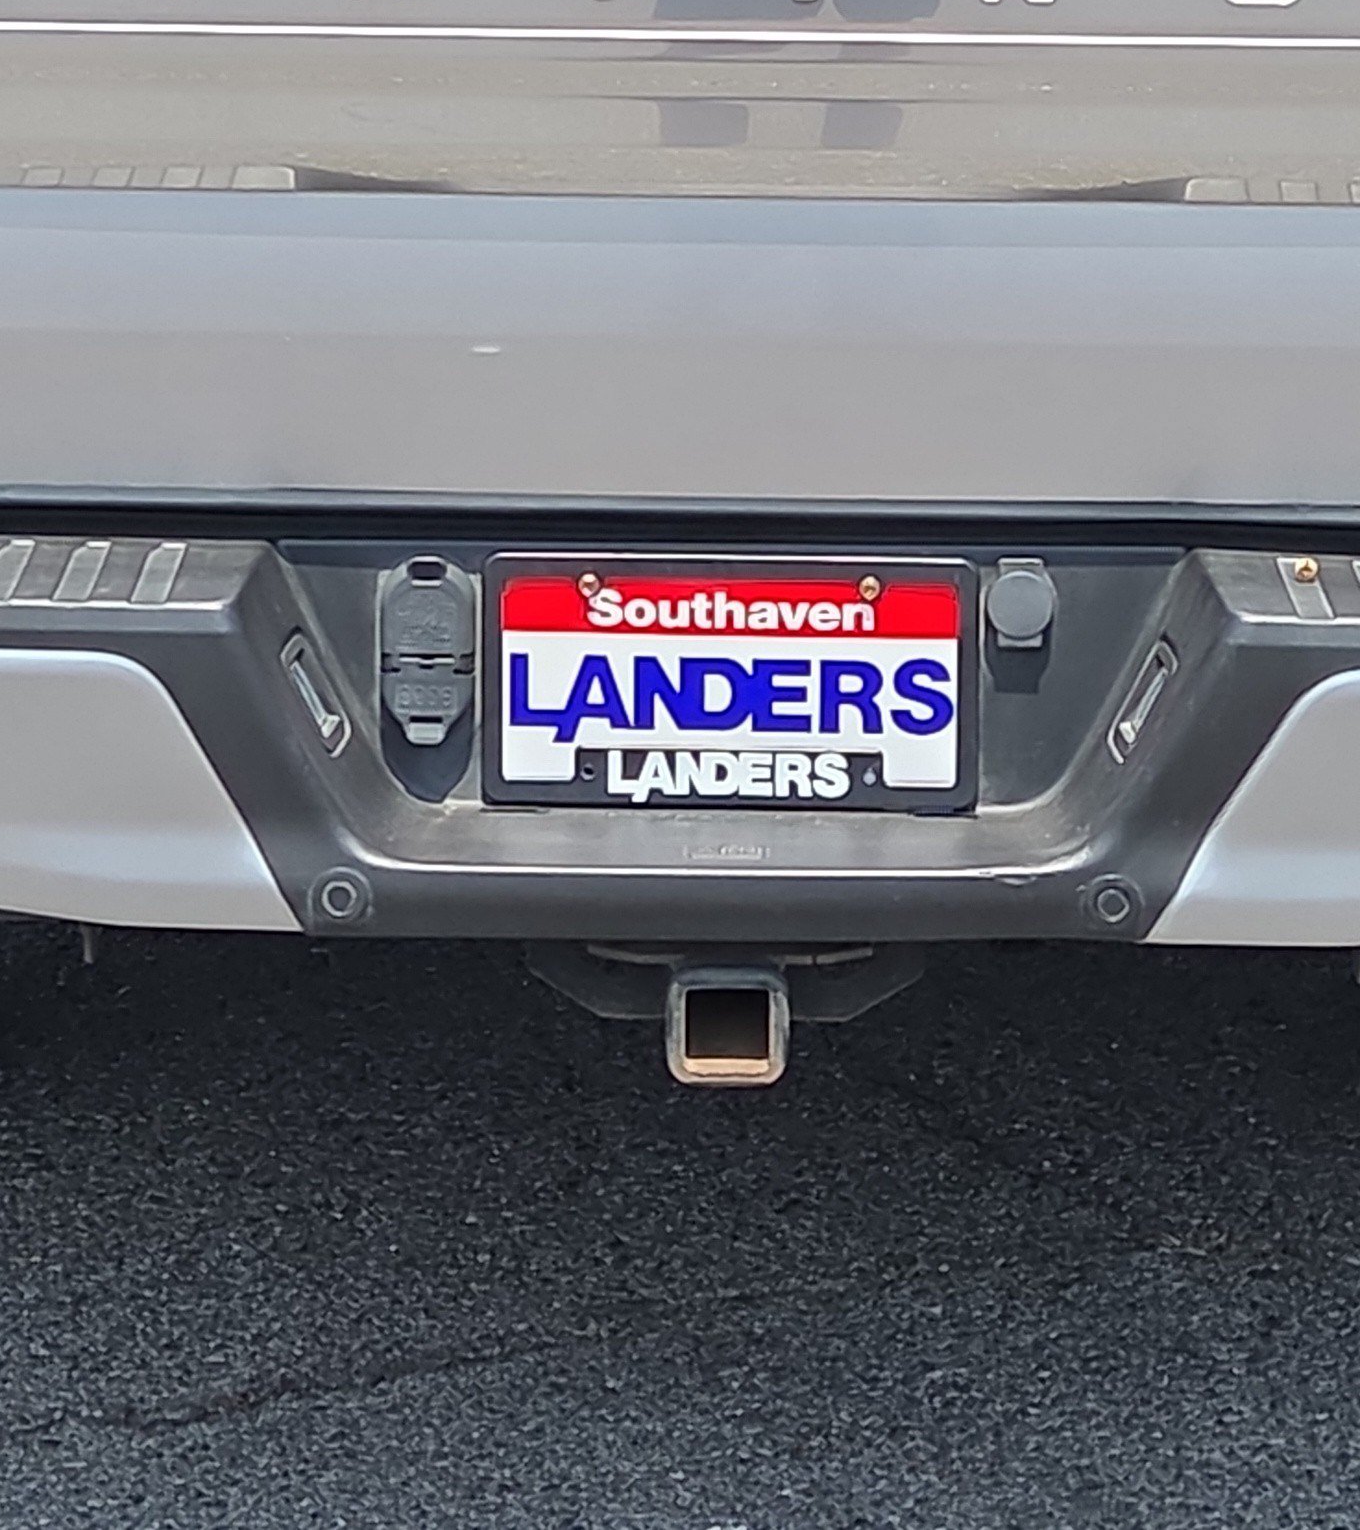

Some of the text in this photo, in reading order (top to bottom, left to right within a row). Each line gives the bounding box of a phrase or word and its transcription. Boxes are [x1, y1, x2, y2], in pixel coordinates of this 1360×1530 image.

[585, 588, 876, 633] Southaven
[509, 652, 955, 744] LANDERS
[606, 749, 850, 803] LANDERS
